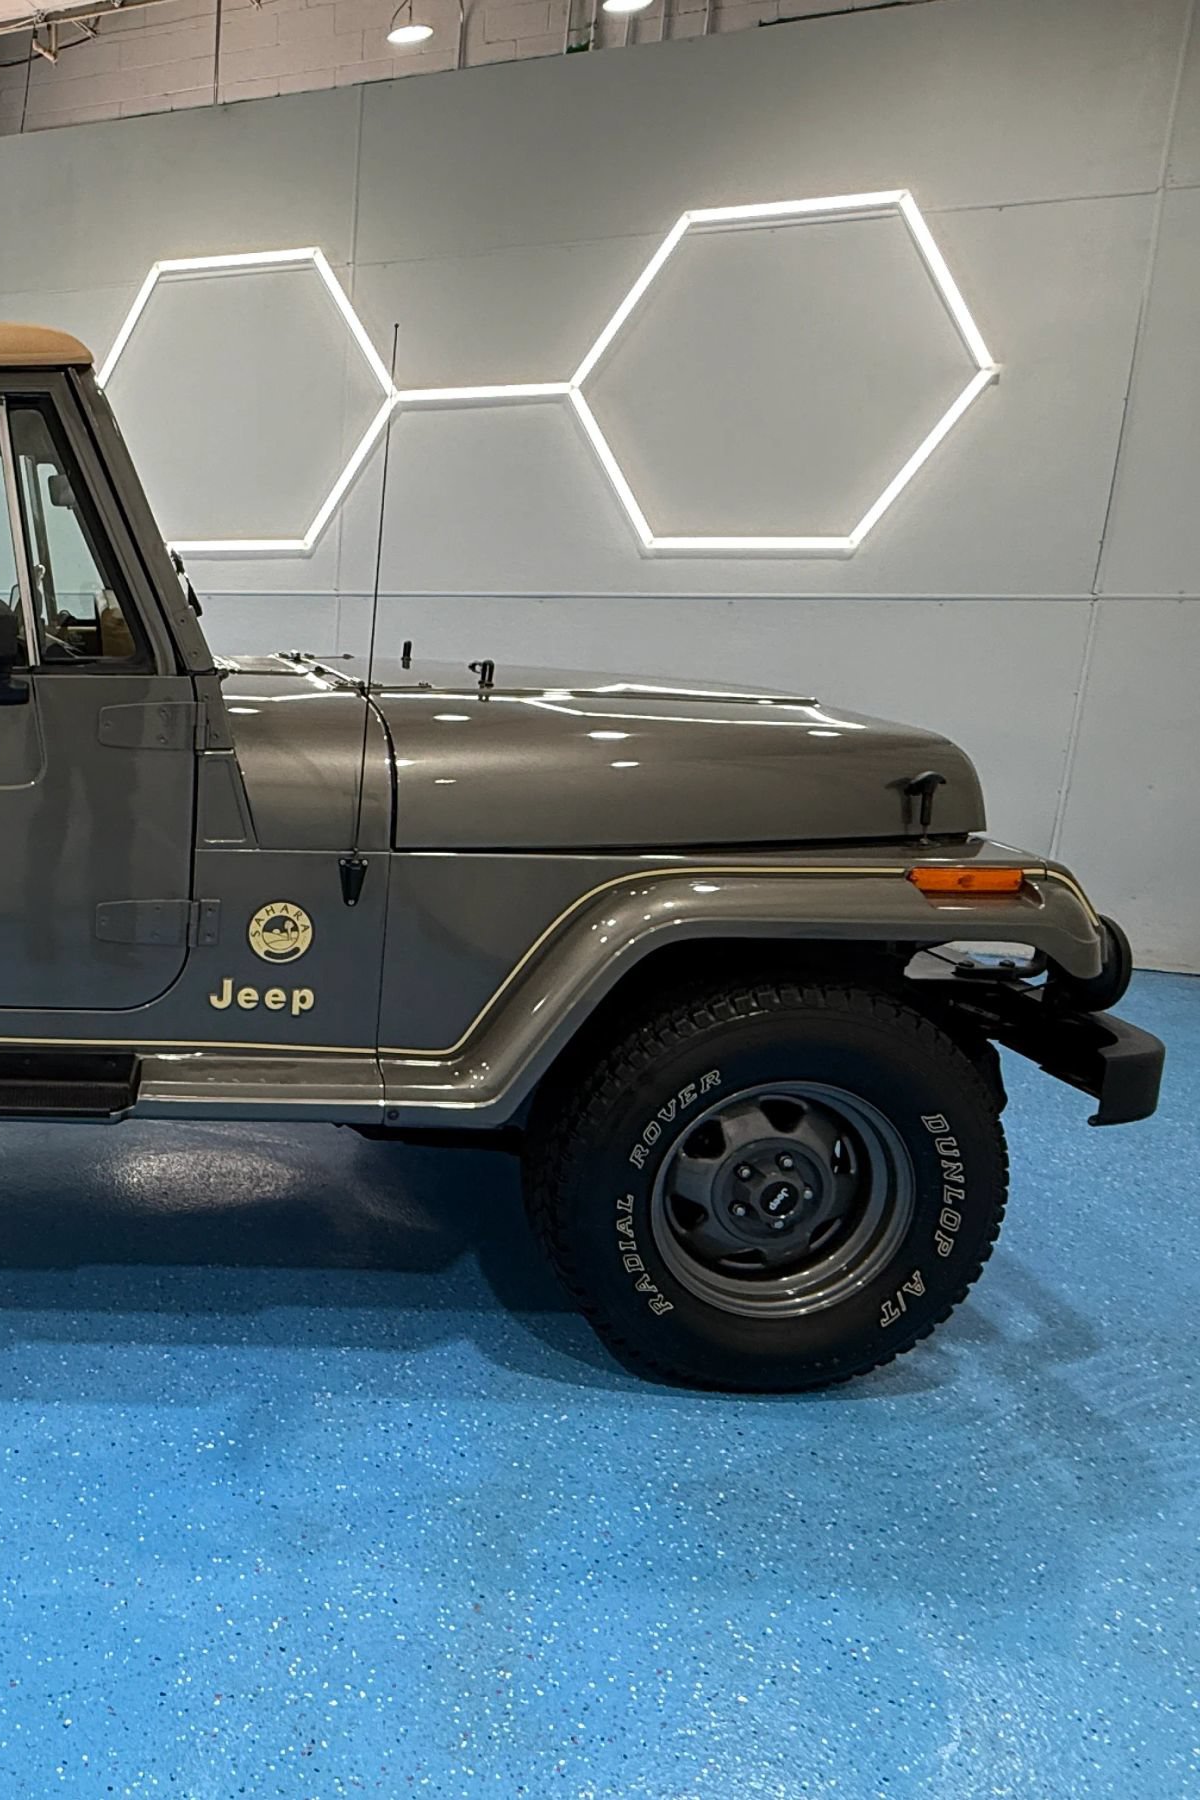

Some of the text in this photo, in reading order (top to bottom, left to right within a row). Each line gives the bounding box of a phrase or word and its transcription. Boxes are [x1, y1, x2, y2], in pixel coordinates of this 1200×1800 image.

[250, 904, 310, 938] SAHARA
[209, 978, 315, 1016] Jeep
[616, 1069, 722, 1316] RADIAL ROVER
[769, 1188, 789, 1210] Jeep
[879, 1113, 966, 1328] DUNLOP A/T
